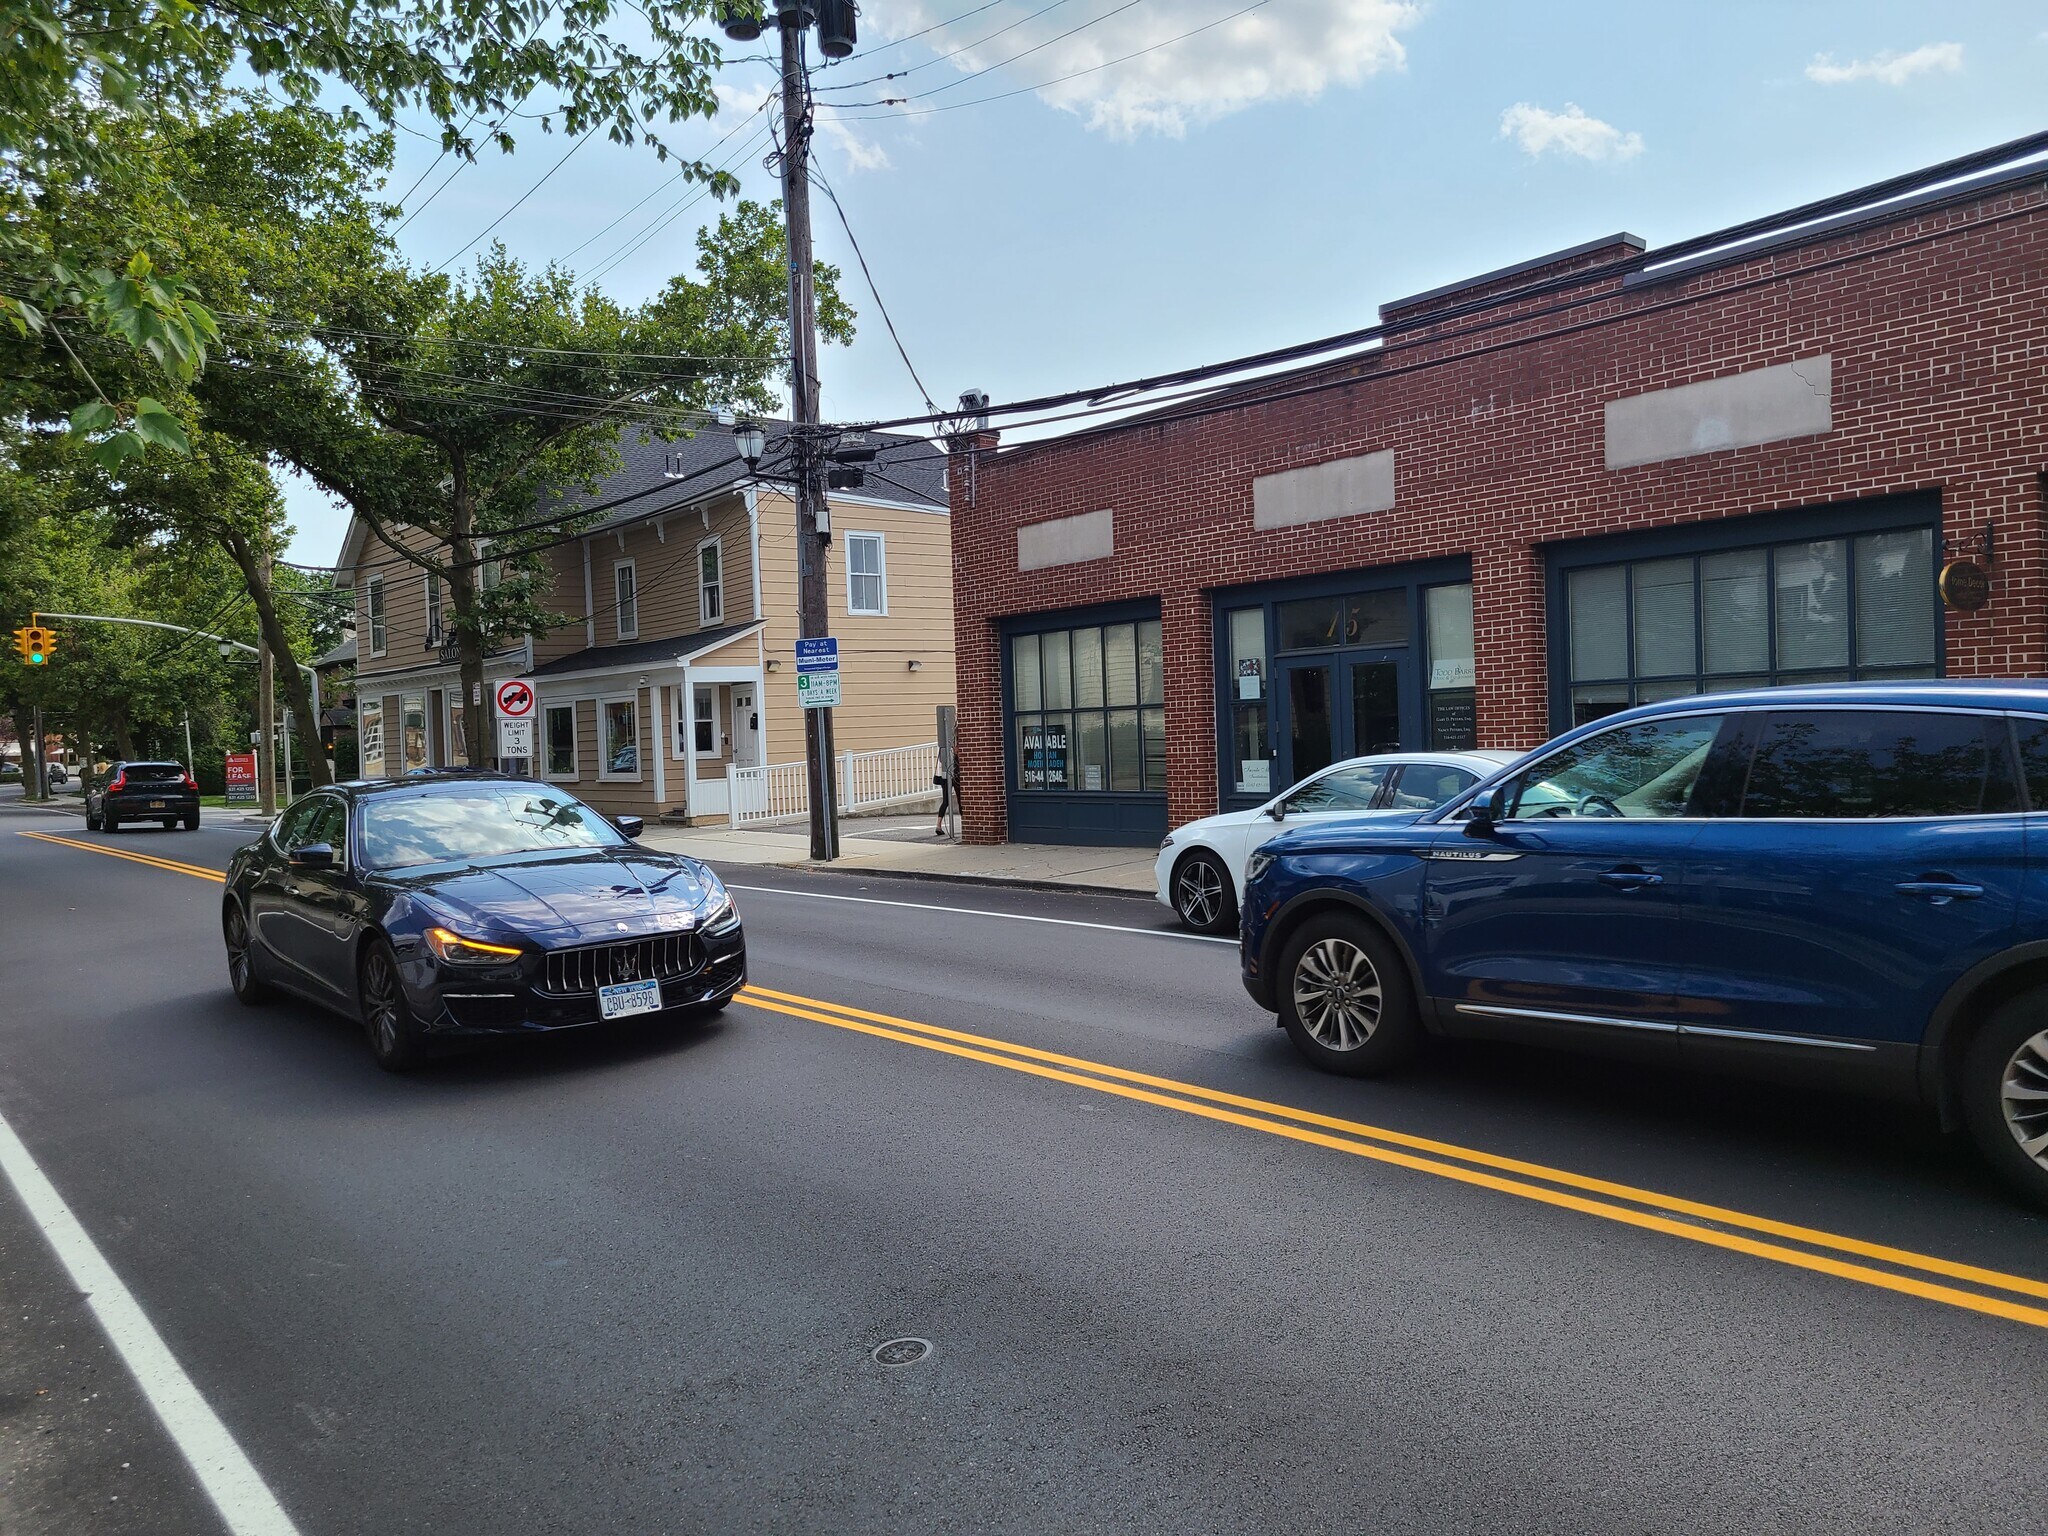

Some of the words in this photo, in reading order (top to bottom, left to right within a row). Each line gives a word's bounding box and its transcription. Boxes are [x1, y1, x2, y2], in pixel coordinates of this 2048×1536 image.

[1327, 608, 1360, 637] 15
[440, 646, 461, 660] SALON
[799, 656, 836, 664] Muni-Meter
[800, 677, 807, 688] 3
[1024, 735, 1066, 749] AVAIABLE
[506, 746, 528, 754] TONS
[1432, 851, 1481, 859] NAUTILUS
